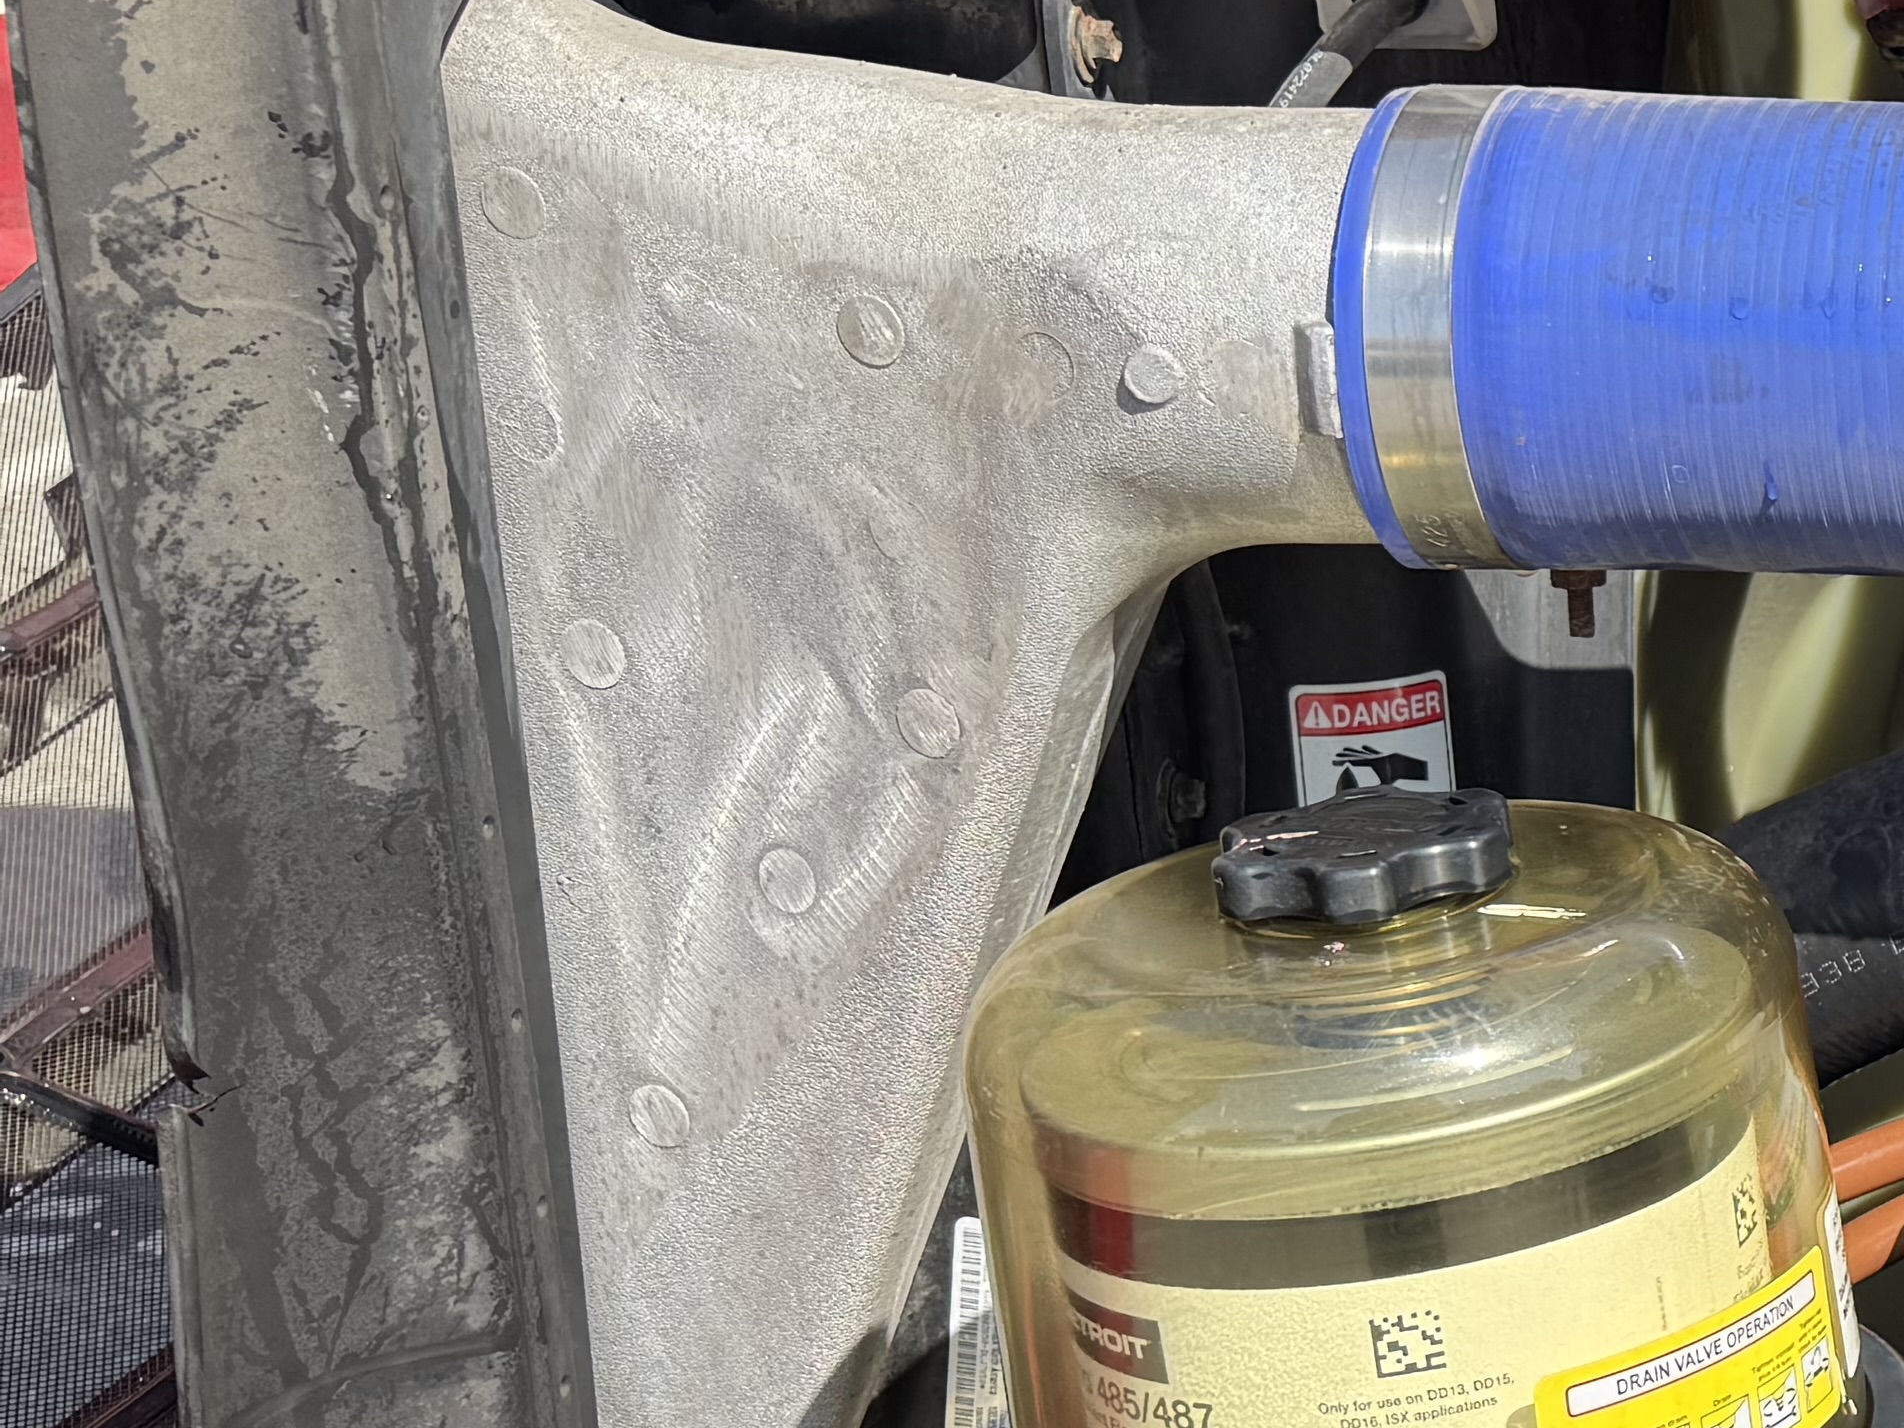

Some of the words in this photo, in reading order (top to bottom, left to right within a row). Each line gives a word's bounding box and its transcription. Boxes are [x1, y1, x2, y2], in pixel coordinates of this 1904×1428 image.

[1332, 690, 1441, 728] DANGER
[1616, 1360, 1670, 1396] DRAIN
[1674, 1338, 1722, 1372] VALVE
[1726, 1294, 1794, 1348] OPERATION
[1318, 1402, 1350, 1416] Only
[1353, 1400, 1372, 1412] for
[1378, 1397, 1402, 1409] use
[1406, 1394, 1424, 1405] on
[1427, 1384, 1469, 1401] DD13,
[1473, 1373, 1515, 1392] DD15,
[1386, 1410, 1409, 1426] ISX
[1414, 1396, 1498, 1423] applications
